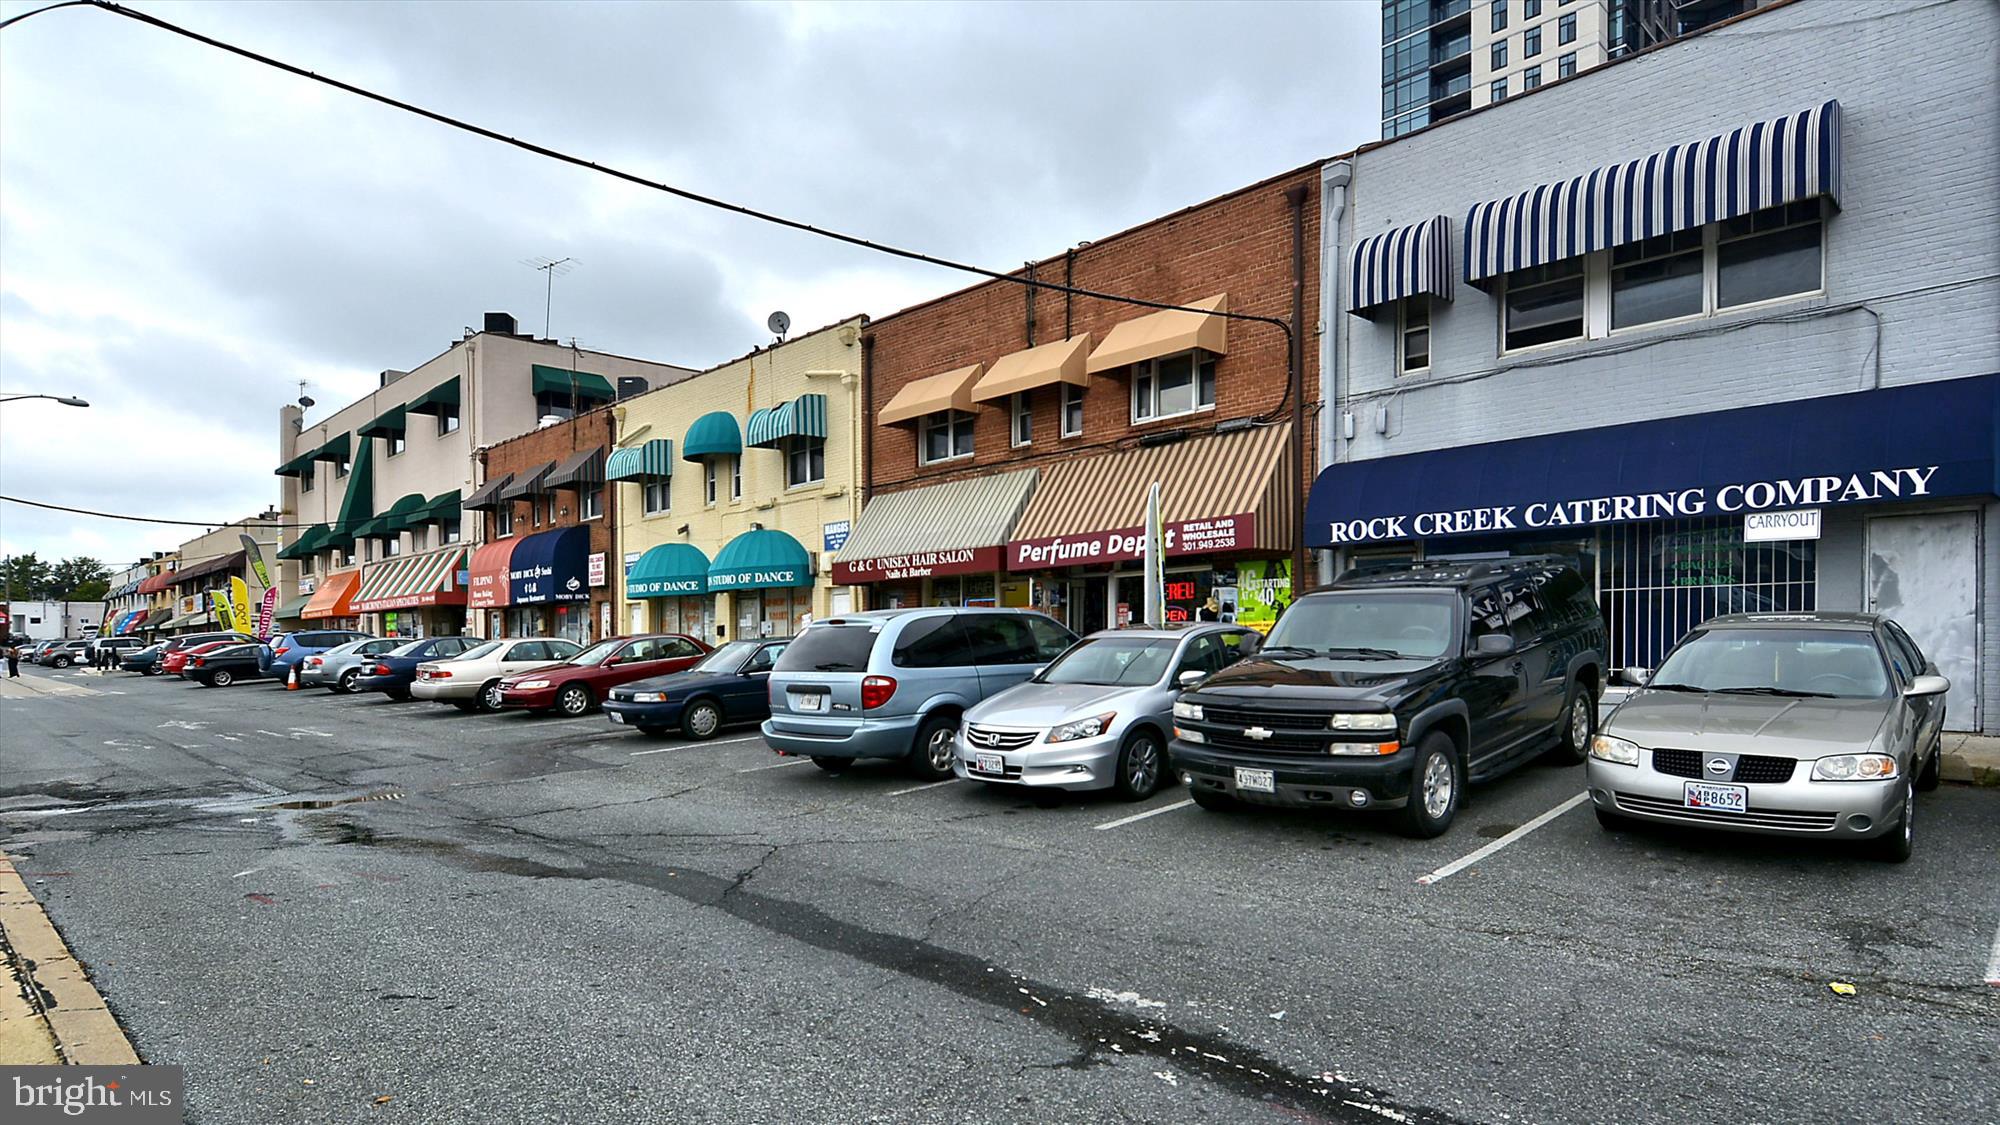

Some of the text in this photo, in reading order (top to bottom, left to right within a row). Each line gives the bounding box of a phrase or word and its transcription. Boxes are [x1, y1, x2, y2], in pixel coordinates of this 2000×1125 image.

[1330, 466, 1939, 543] ROCK CREEK CATERING COMPANY
[1183, 519, 1234, 533] RETAIL AND
[1748, 511, 1818, 529] CARRYOUT
[1182, 528, 1236, 541] WHOLESALE
[1018, 529, 1176, 565] Perfume Dept
[1182, 537, 1236, 552] 301.949.2538
[849, 549, 975, 573] G & C UNISEX HAIR SALON
[738, 573, 752, 583] OF
[755, 571, 794, 583] DANCE
[885, 567, 932, 580] Nails & Barber
[649, 582, 661, 592] OF
[664, 581, 699, 591] DANCE
[1255, 577, 1291, 589] STARTING
